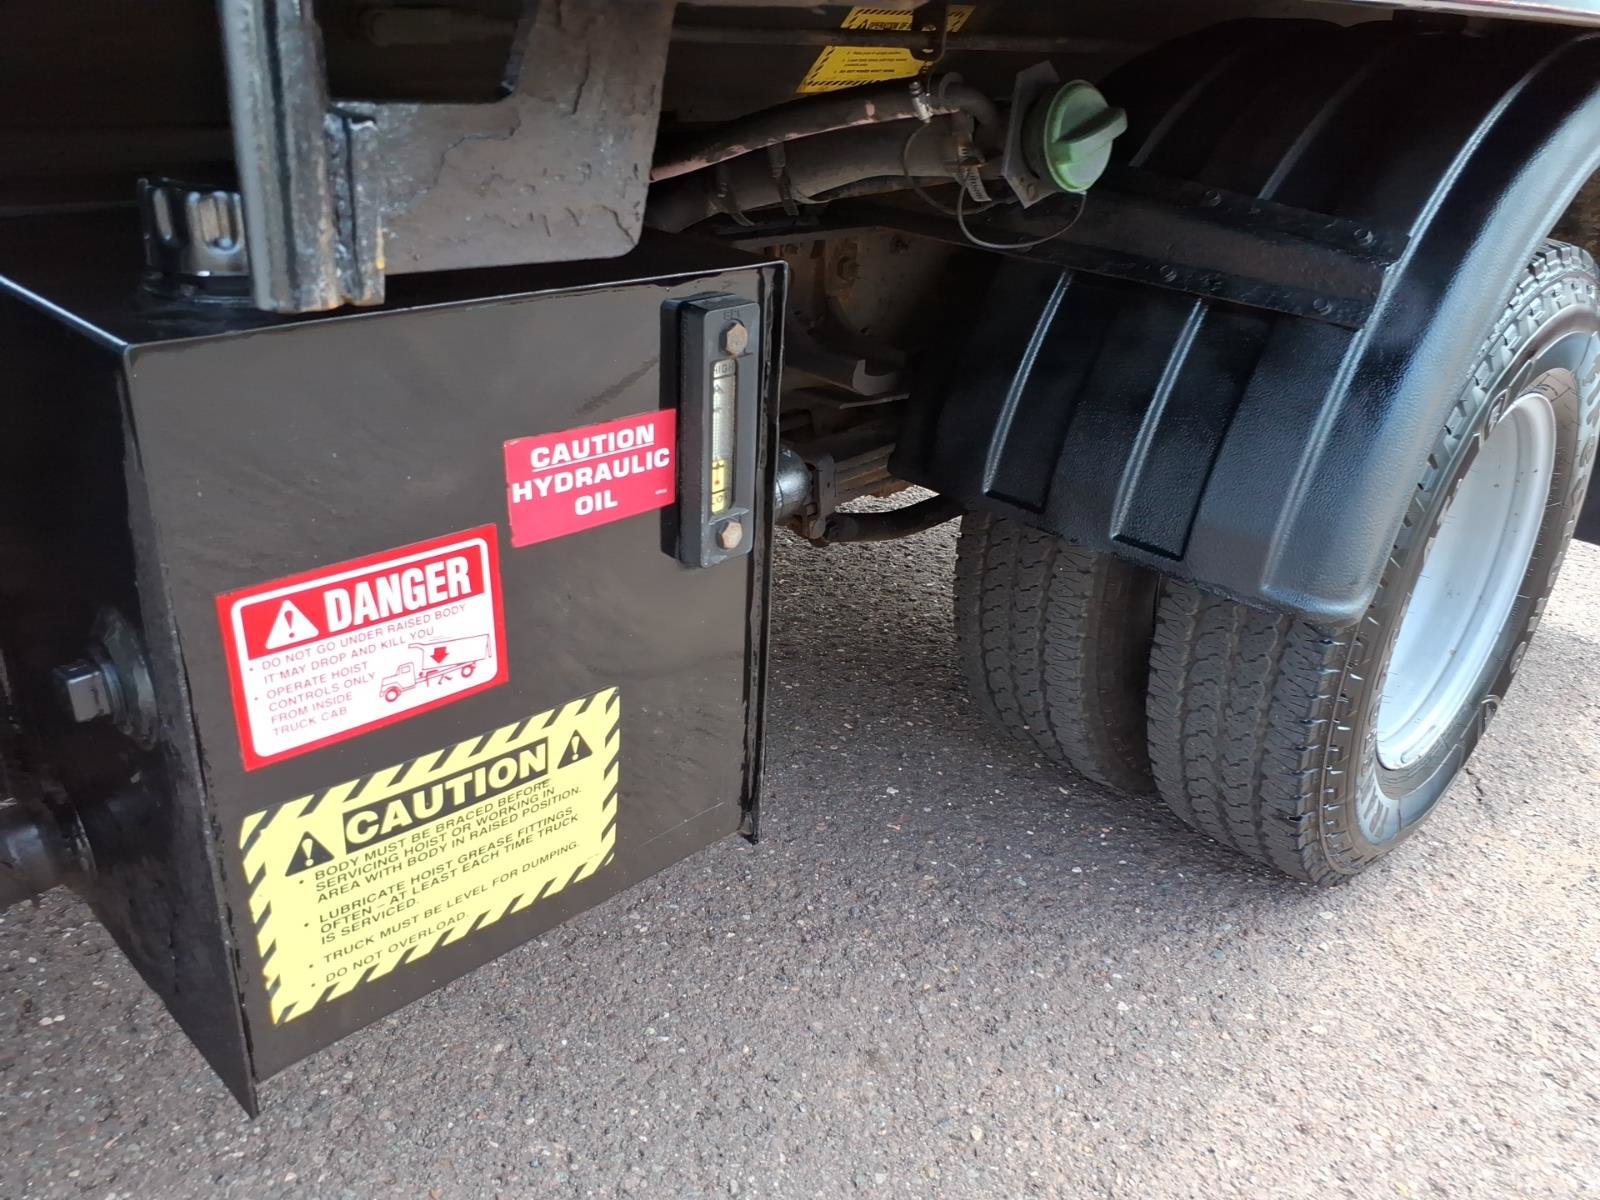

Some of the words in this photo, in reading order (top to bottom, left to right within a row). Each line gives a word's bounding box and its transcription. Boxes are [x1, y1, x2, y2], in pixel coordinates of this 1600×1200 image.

[511, 447, 671, 503] HYDRAULIC
[530, 423, 655, 469] CAUTION
[574, 489, 618, 516] OIL
[323, 555, 472, 633] DANGER
[262, 657, 281, 670] DO
[285, 647, 311, 663] NOT
[316, 641, 336, 654] GO
[340, 627, 384, 648] UNDER
[387, 614, 431, 633] RAISED
[434, 604, 465, 620] BODY
[264, 673, 275, 684] IT
[280, 664, 306, 679] MAY
[311, 652, 347, 671] DROP
[351, 644, 376, 659] AND
[380, 636, 406, 649] KILL
[410, 626, 434, 641] YOU
[266, 673, 328, 699] OPERATE
[331, 661, 368, 680] HOIST
[269, 682, 340, 712] CONTROLS
[343, 672, 376, 689] ONLY
[271, 706, 308, 724] FROM
[312, 691, 352, 711] INSIDE
[273, 717, 317, 736] TRUCK
[321, 706, 348, 721] CAB
[345, 742, 546, 845] CAUTION
[315, 856, 359, 881] BODY
[364, 838, 406, 862] MUST
[411, 828, 431, 843] BE
[435, 802, 494, 833] BRACED
[498, 779, 551, 807] BEFORE
[316, 853, 399, 892] SERVICING
[404, 833, 447, 857] HOIST
[452, 822, 472, 837] OR
[476, 796, 539, 827] WORKING
[543, 787, 555, 799] IN
[318, 880, 361, 903] AREA
[365, 862, 402, 884] WITH
[407, 843, 447, 867] BODY
[452, 836, 465, 848] IN
[469, 813, 518, 840] RAISED
[522, 786, 582, 818] POSITION.
[319, 880, 405, 923] LUBRICATE
[410, 860, 453, 885] HOIST
[457, 834, 513, 864] GREASE
[517, 806, 573, 838] FITTINGS
[320, 906, 373, 934] OFTEN
[389, 891, 407, 905] AT
[412, 869, 458, 895] LEAST
[462, 850, 500, 872] EACH
[503, 834, 534, 853] TIME
[537, 814, 579, 838] TRUCK
[321, 932, 336, 945] IS
[324, 935, 375, 964] TRUCK
[380, 914, 420, 939] MUST
[424, 903, 443, 919] BE
[446, 884, 489, 908] LEVEL
[492, 869, 518, 887] FOR
[326, 967, 348, 983] DO
[352, 950, 383, 970] NOT
